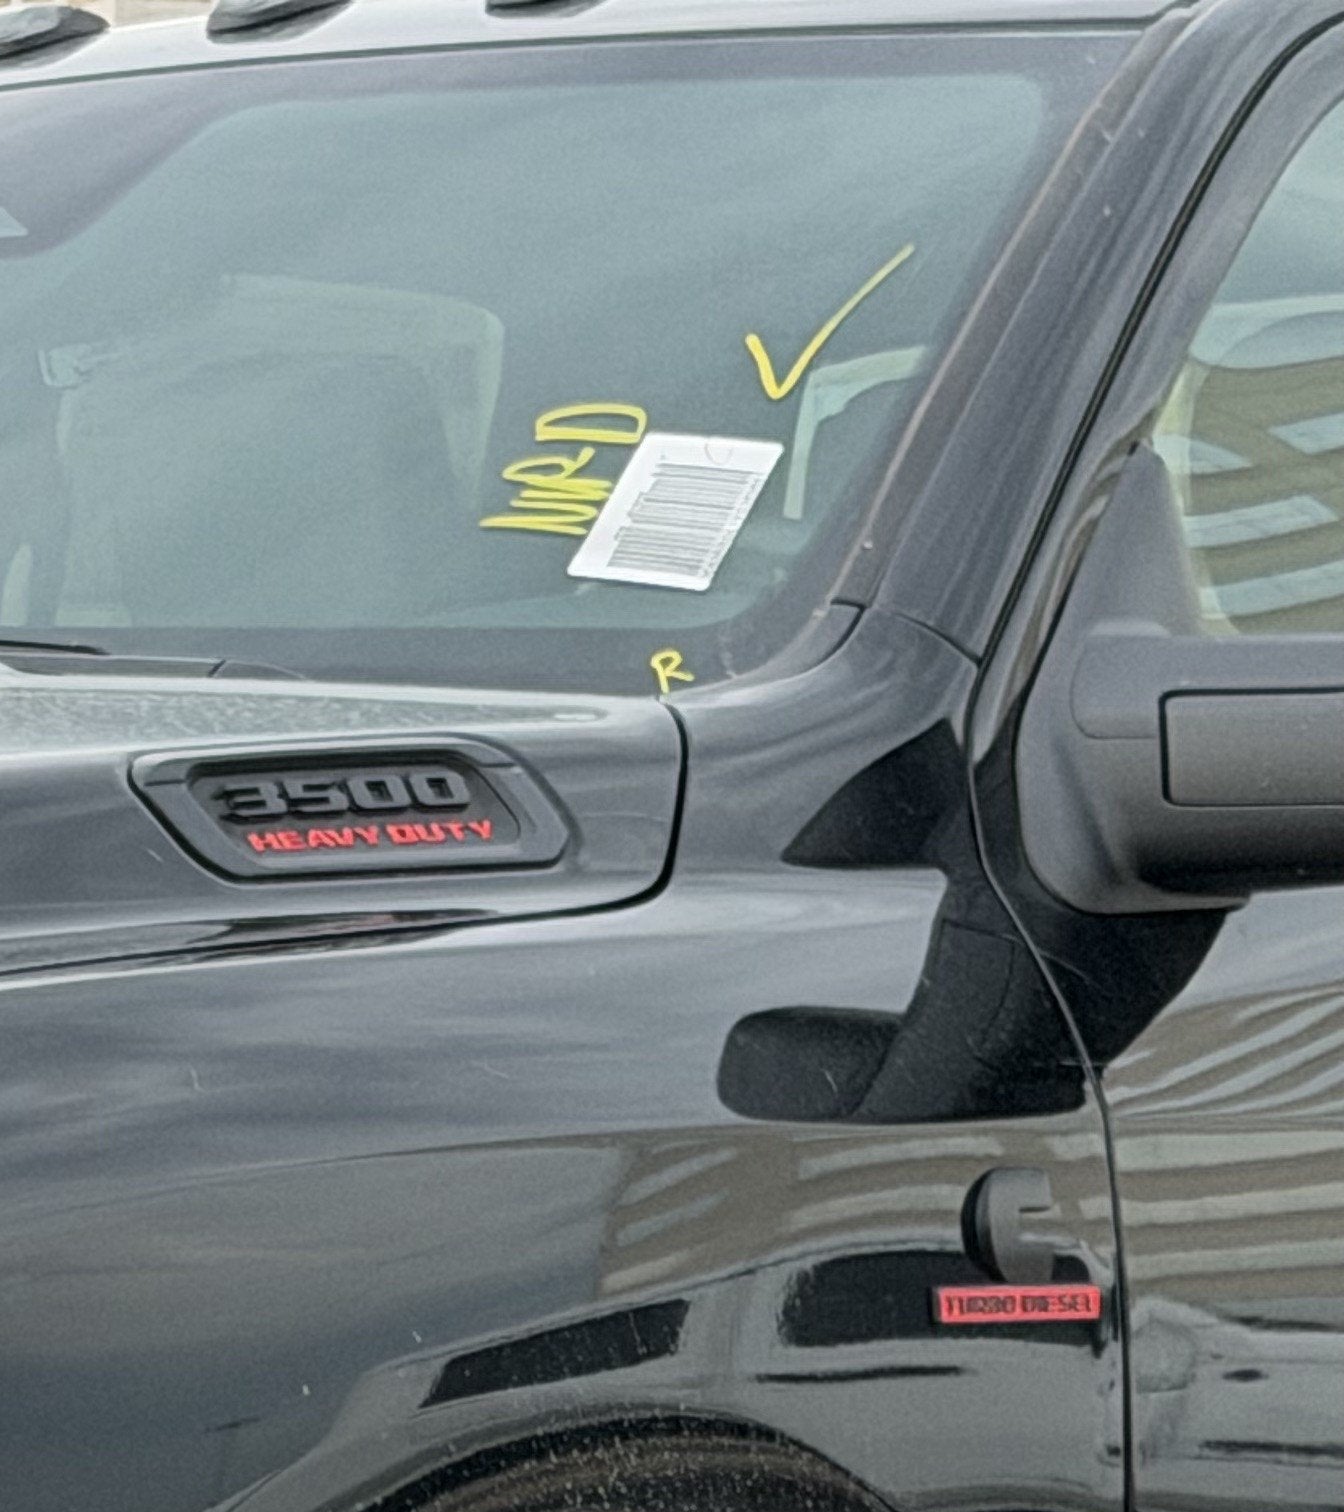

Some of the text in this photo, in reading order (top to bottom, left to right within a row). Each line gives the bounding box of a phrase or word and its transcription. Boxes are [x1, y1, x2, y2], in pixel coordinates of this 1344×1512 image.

[220, 770, 472, 821] 3500
[246, 819, 494, 854] HEAVY DUTY
